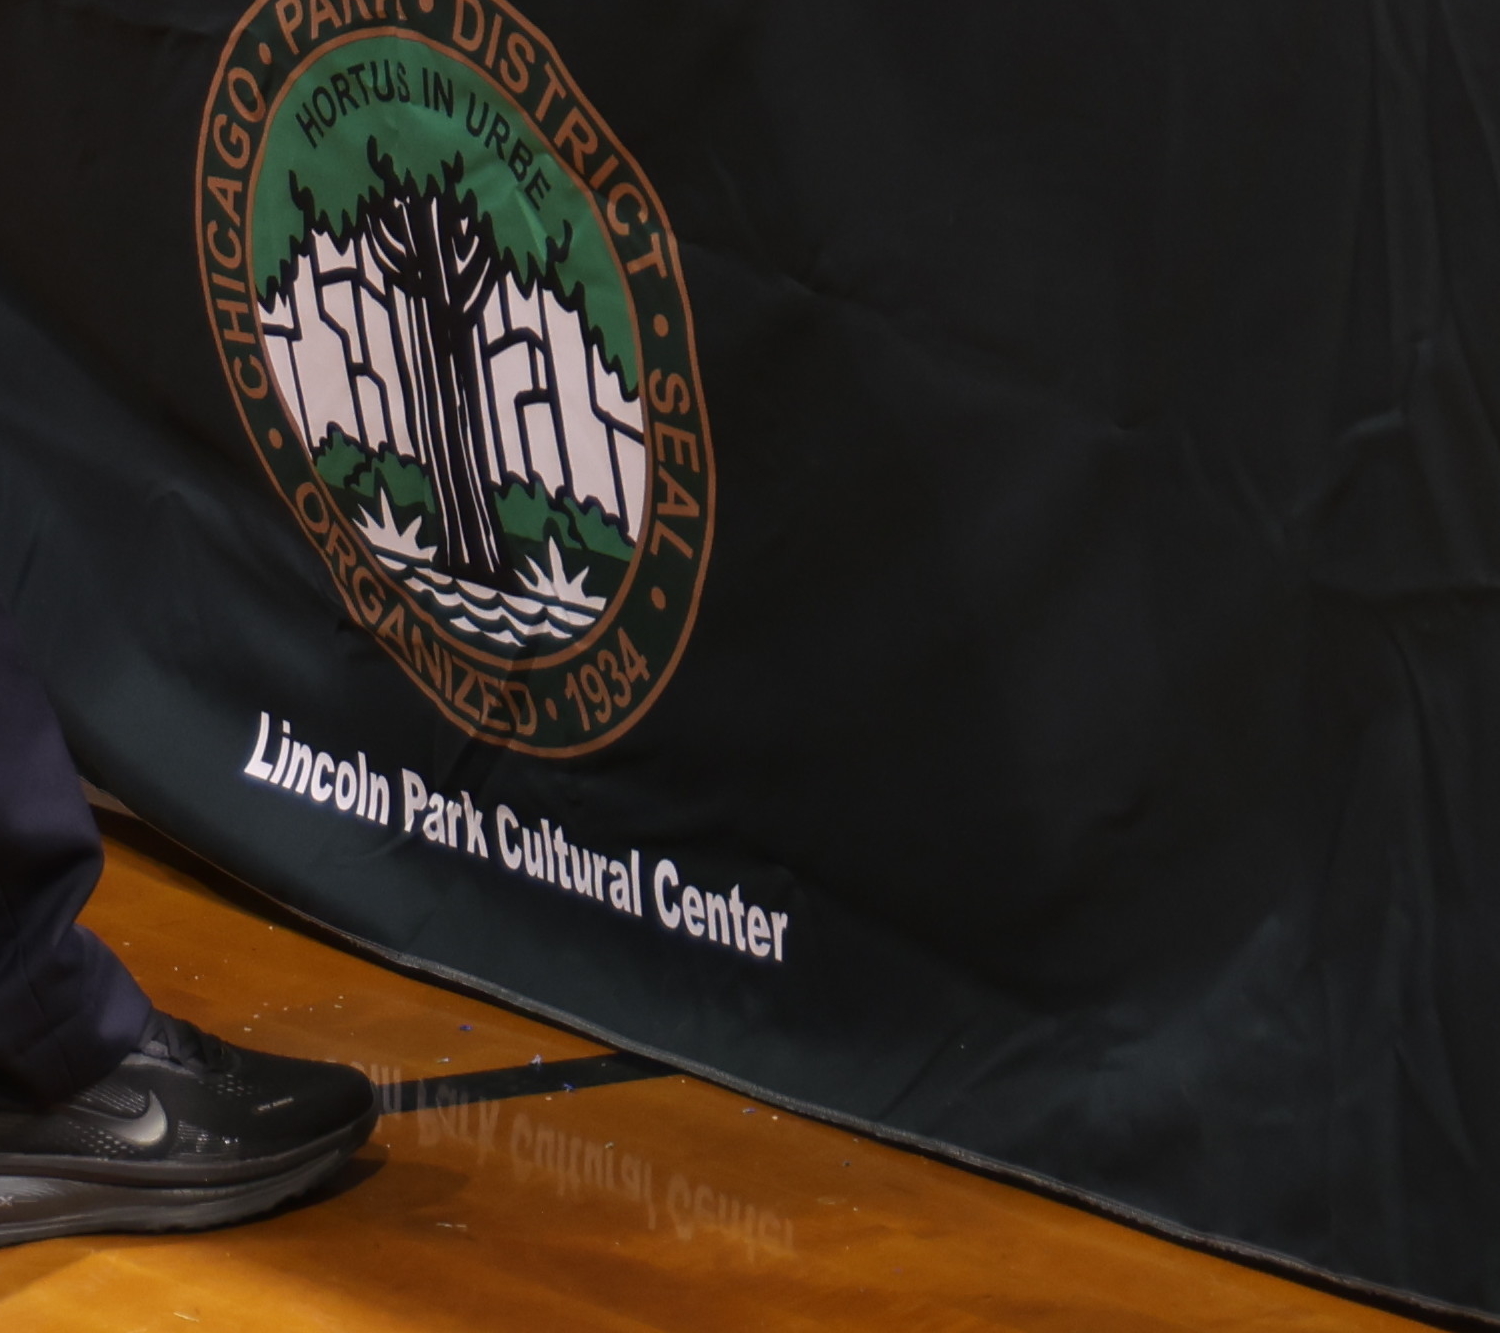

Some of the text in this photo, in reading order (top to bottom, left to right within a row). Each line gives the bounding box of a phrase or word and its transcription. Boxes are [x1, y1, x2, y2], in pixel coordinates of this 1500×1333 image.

[295, 59, 551, 213] HORTUS IN URBE
[211, 67, 269, 402] CHICAGO
[647, 370, 702, 559] SEAL
[291, 479, 651, 732] ORGANIZED 1934
[243, 710, 790, 962] Lincoln Park Cultural Center
